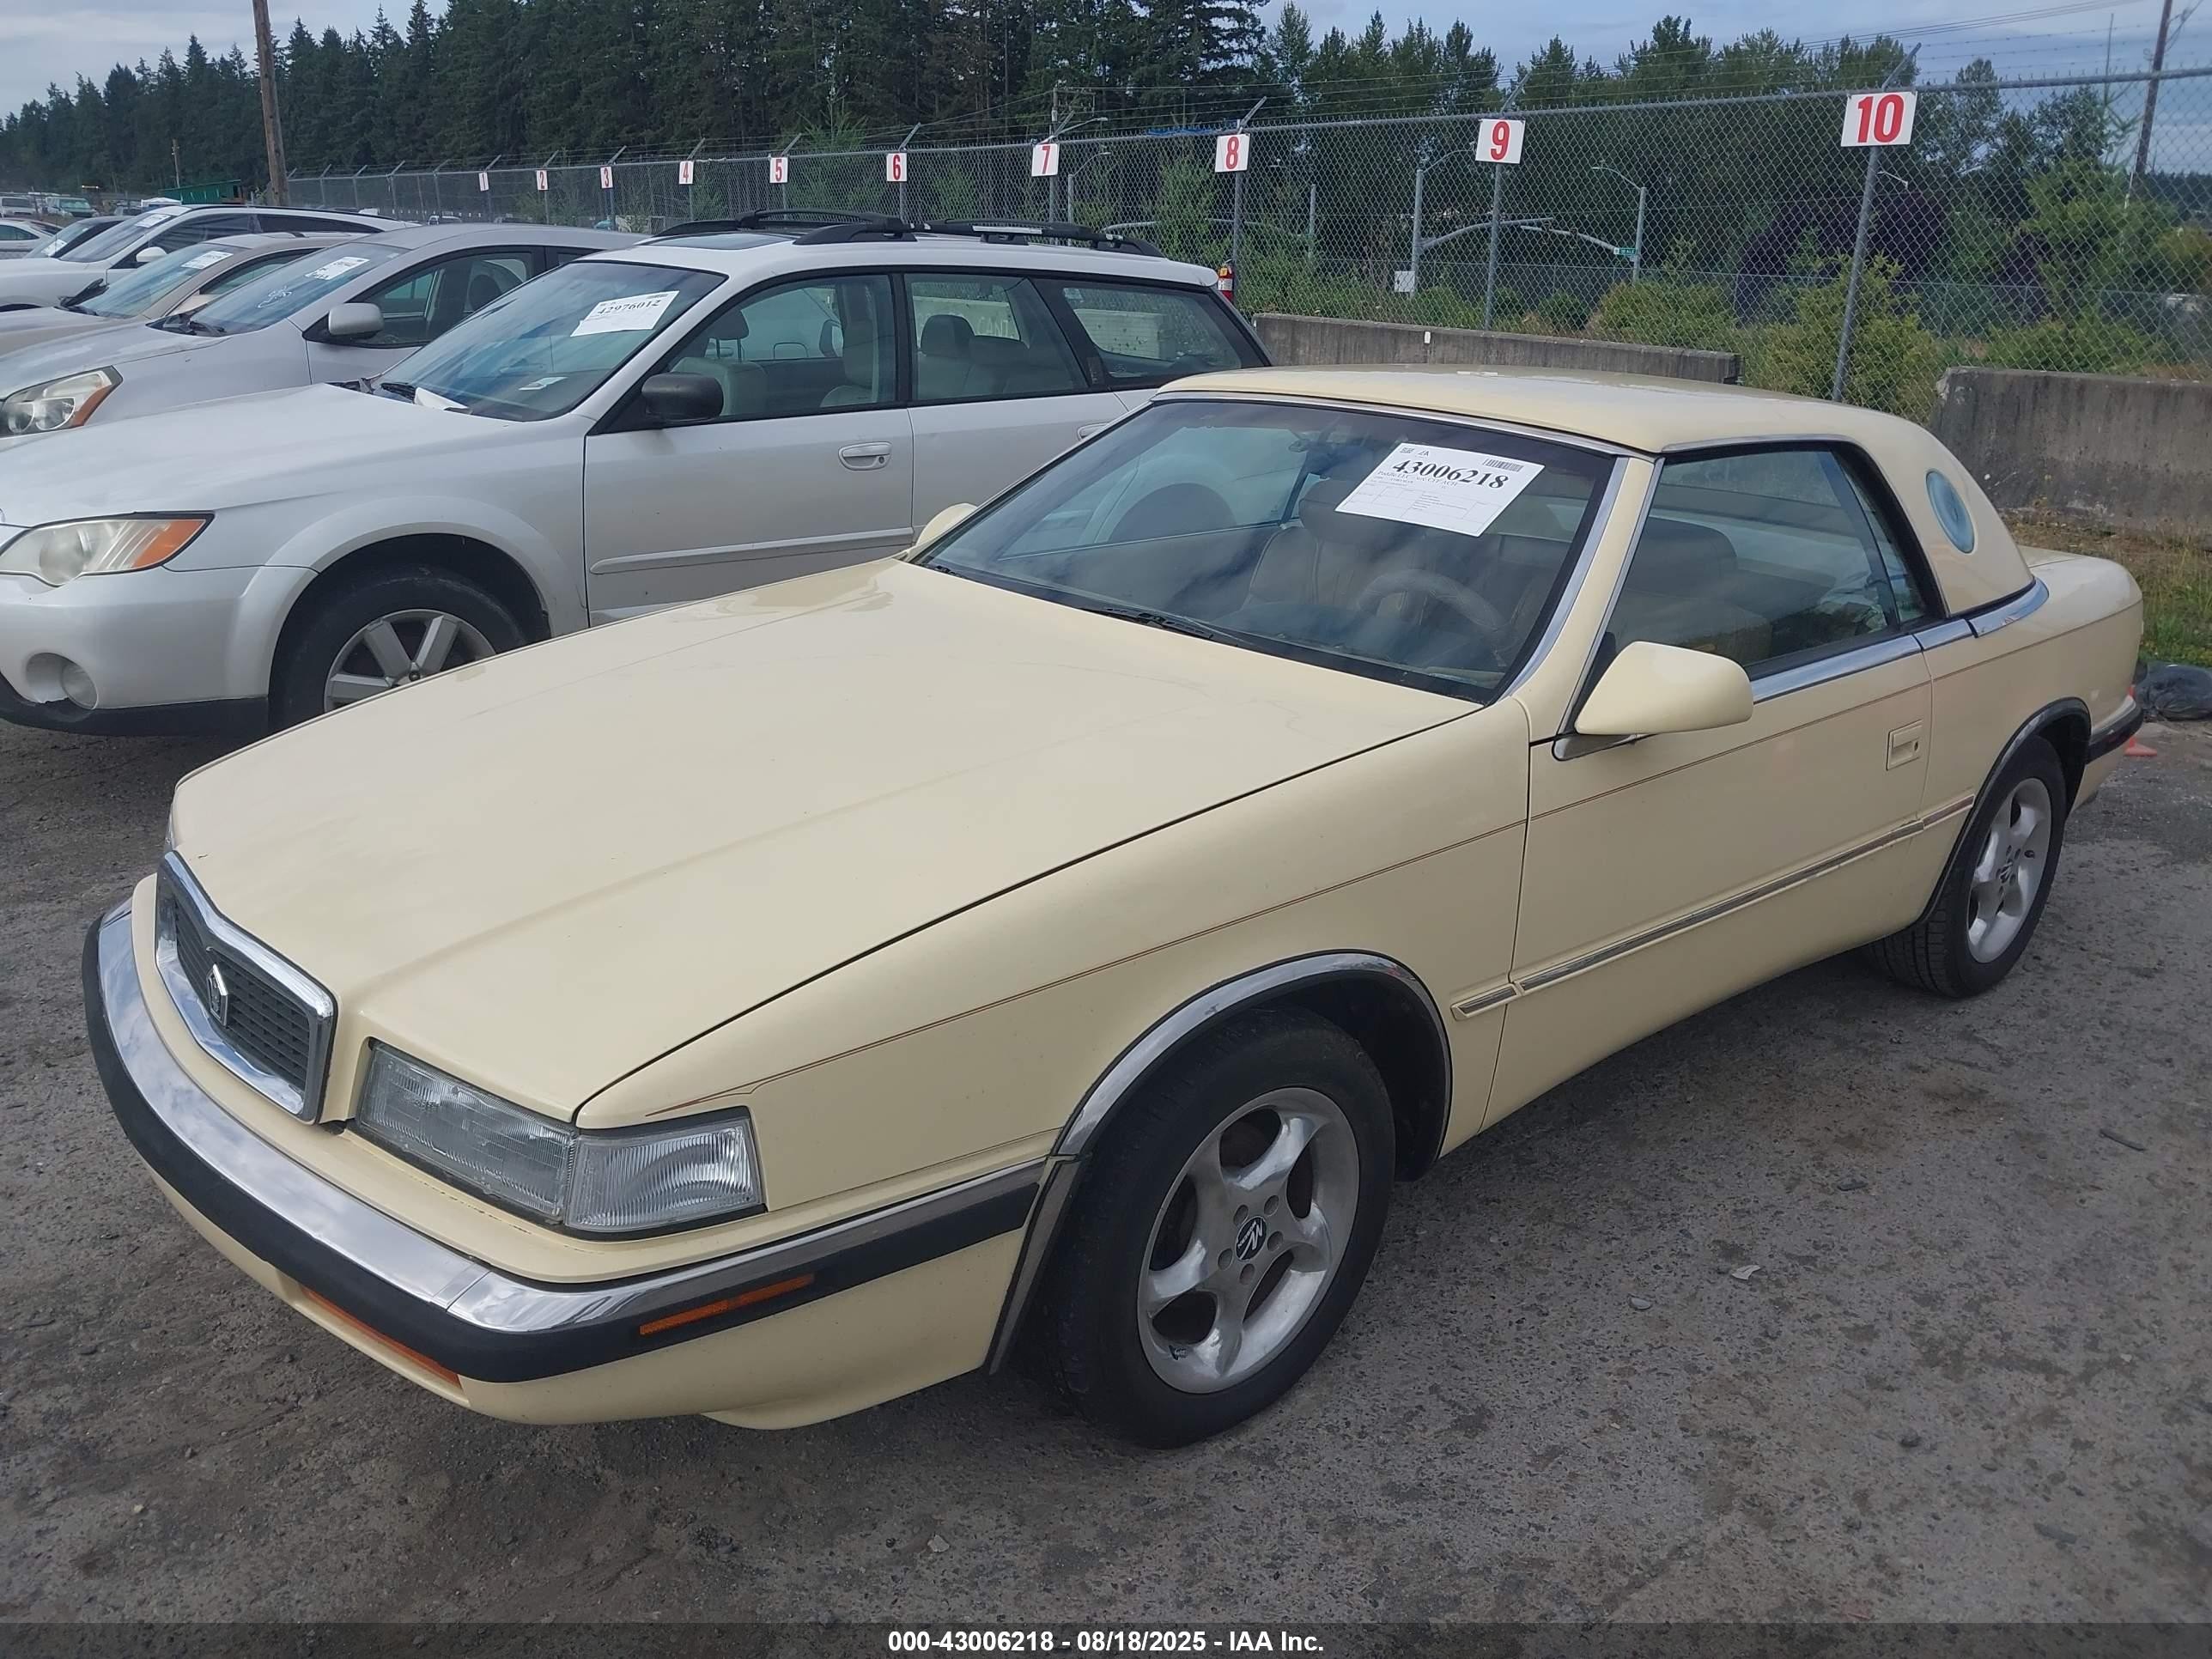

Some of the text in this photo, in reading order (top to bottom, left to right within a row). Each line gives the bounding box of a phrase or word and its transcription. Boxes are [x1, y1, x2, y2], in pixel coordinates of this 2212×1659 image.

[1857, 94, 1905, 143] 10
[1490, 120, 1510, 161] 9
[1042, 145, 1051, 174] 7
[1225, 137, 1239, 170] 8
[605, 167, 609, 187] 3
[684, 162, 689, 183] 4
[775, 159, 782, 181] 5
[893, 155, 901, 180] 6
[539, 172, 545, 189] 2
[598, 299, 661, 315] 42976012
[1392, 459, 1510, 489] 43006218
